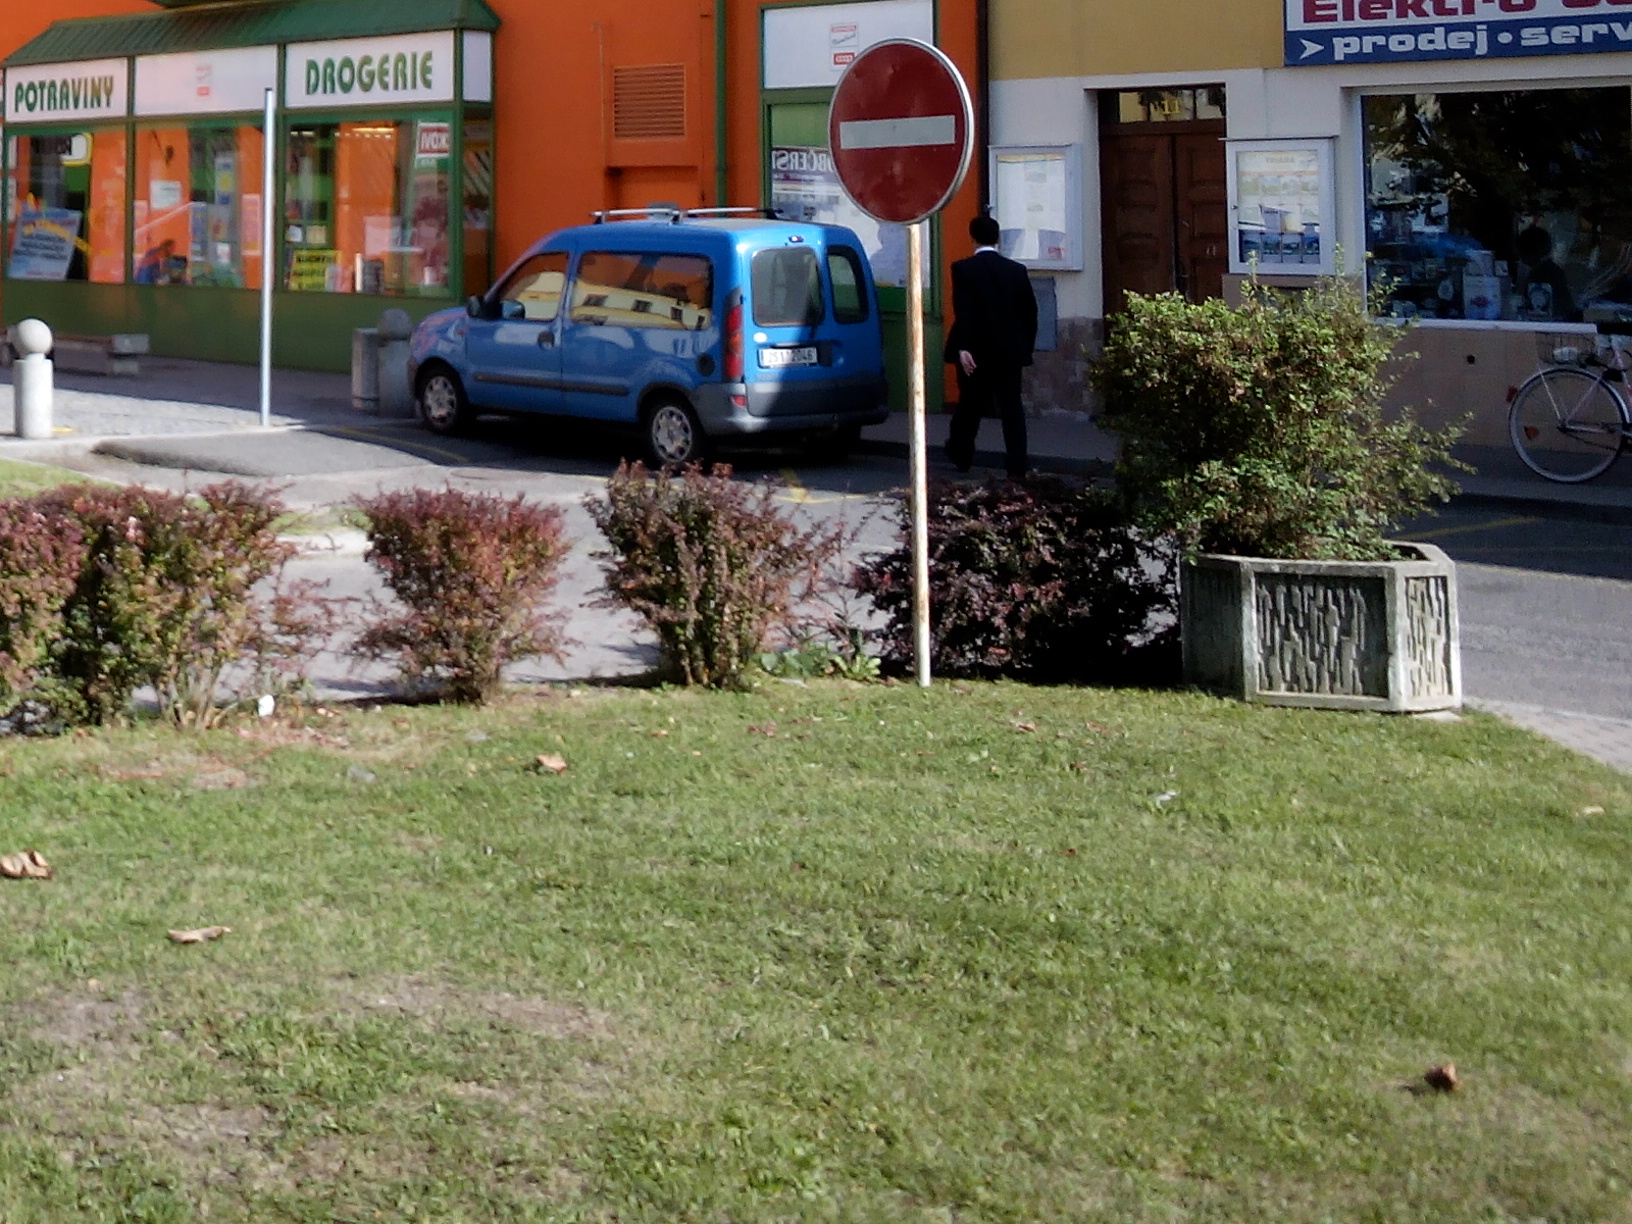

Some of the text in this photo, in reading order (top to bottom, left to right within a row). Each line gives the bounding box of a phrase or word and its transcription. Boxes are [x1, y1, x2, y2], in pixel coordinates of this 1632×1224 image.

[1331, 25, 1488, 61] prodej
[305, 51, 433, 95] DROGERIE
[14, 76, 114, 113] POTRAVINY
